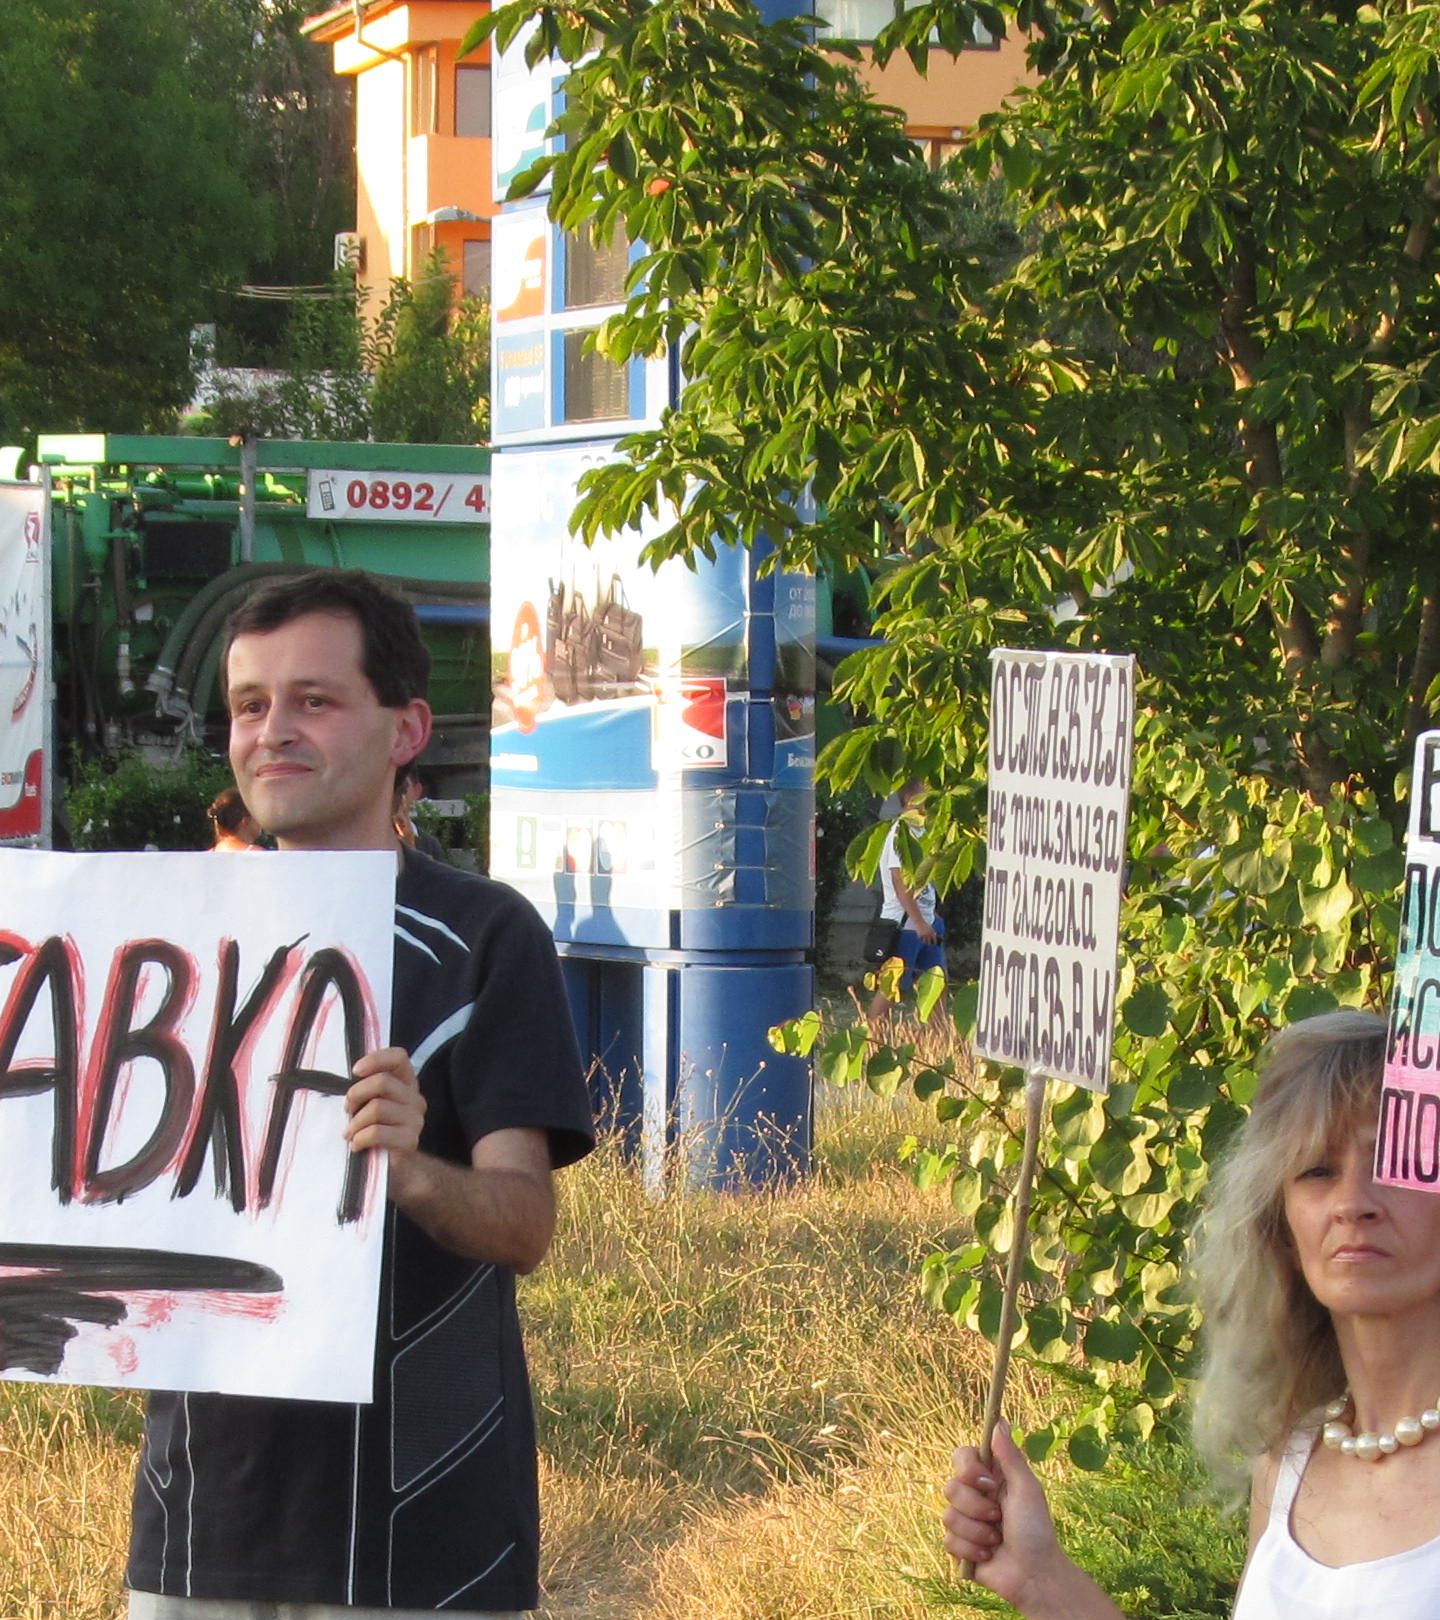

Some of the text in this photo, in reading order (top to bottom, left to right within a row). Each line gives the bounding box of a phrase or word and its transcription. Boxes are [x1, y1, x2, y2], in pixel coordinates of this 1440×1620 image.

[346, 479, 491, 518] 0892/ 4
[992, 659, 1129, 790] ОСТАВКА
[989, 790, 1120, 874] не произлиза
[985, 868, 1097, 952] от глагола
[976, 943, 1110, 1084] ОСТАВАМ
